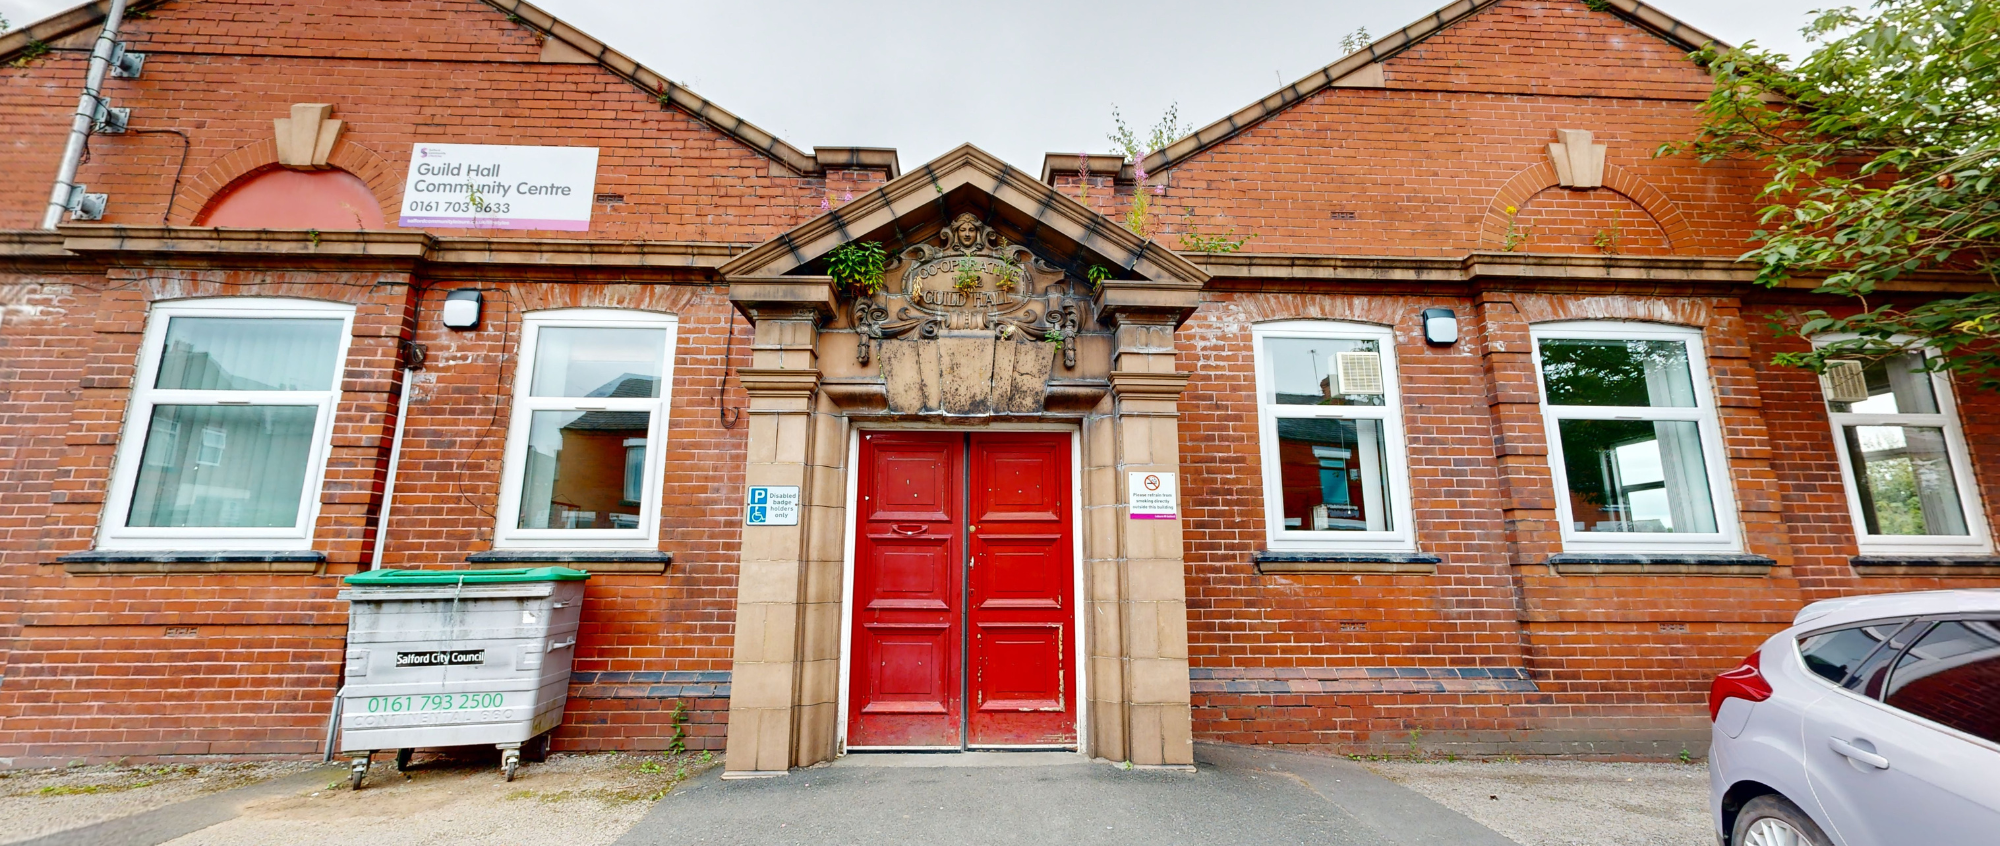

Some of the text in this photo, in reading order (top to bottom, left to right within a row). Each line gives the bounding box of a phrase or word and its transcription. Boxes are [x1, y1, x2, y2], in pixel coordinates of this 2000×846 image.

[417, 162, 500, 178] Guild Hall
[414, 179, 572, 197] Community Centre
[409, 200, 510, 214] 0161 703 8633
[919, 259, 1020, 282] CO-OPERATIE
[923, 290, 1013, 307] GUILD HALL
[755, 490, 765, 503] P
[396, 651, 484, 665] Salford City Council
[367, 693, 504, 713] 0161 793 2500
[353, 711, 472, 727] CONTINENTAL
